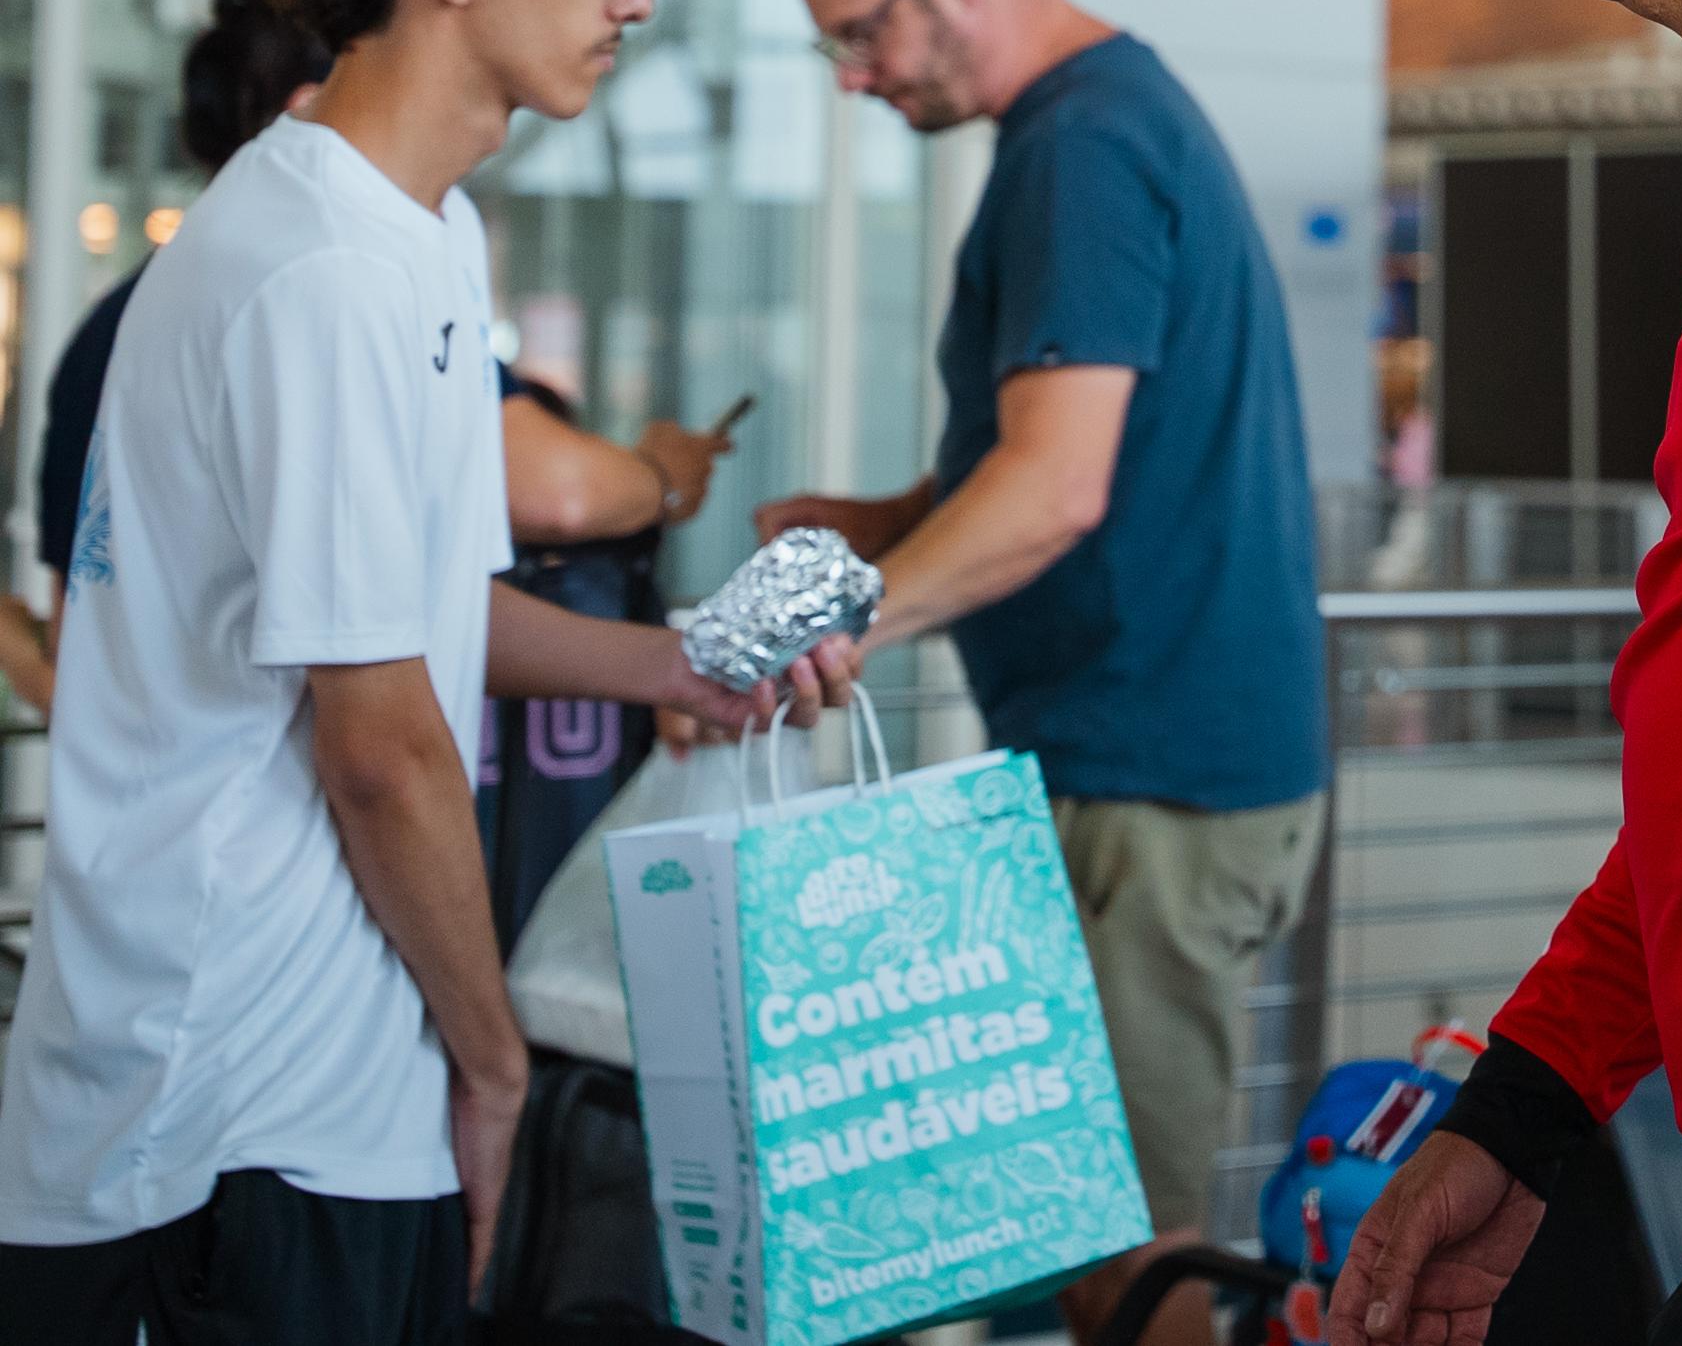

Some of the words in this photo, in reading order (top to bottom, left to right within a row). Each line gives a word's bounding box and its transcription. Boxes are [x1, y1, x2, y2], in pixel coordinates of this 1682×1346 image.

[757, 942, 1009, 1048] Contém
[753, 1000, 1052, 1124] marmitas
[766, 1062, 1073, 1195] saudáveis
[808, 1207, 1063, 1306] bitemylunch.pt
